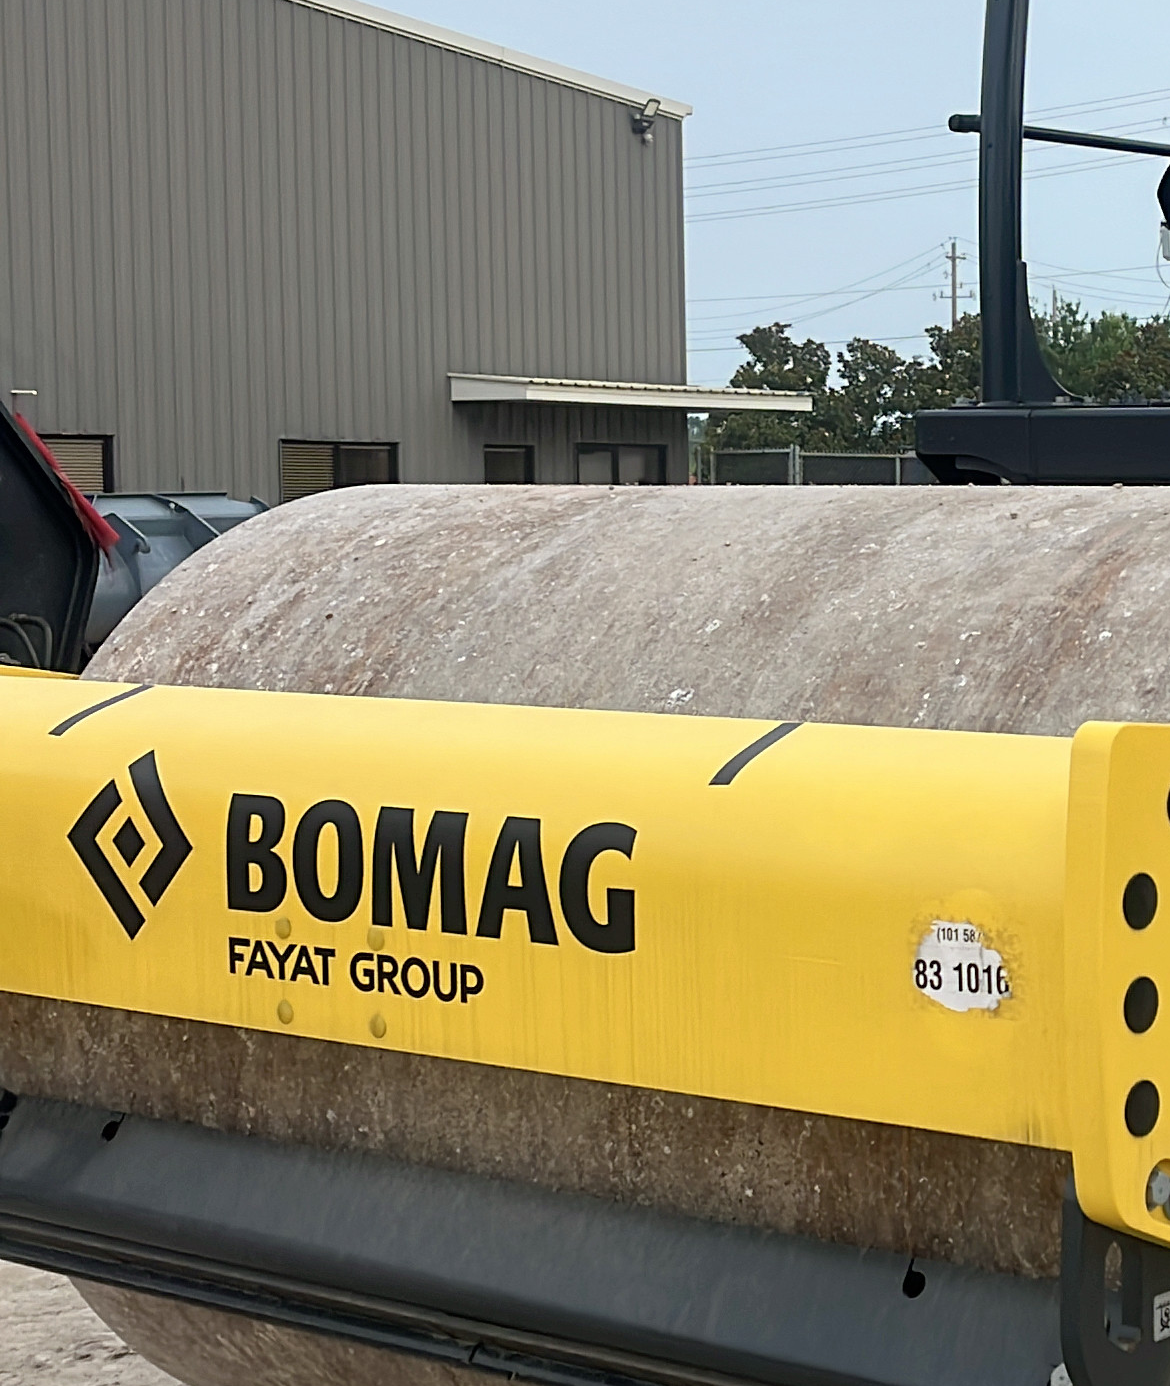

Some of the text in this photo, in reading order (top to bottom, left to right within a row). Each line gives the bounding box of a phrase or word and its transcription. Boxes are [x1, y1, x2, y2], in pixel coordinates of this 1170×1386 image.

[226, 792, 638, 954] BOMAG
[936, 927, 959, 943] (101
[228, 936, 485, 1004] FAYAT GROUP
